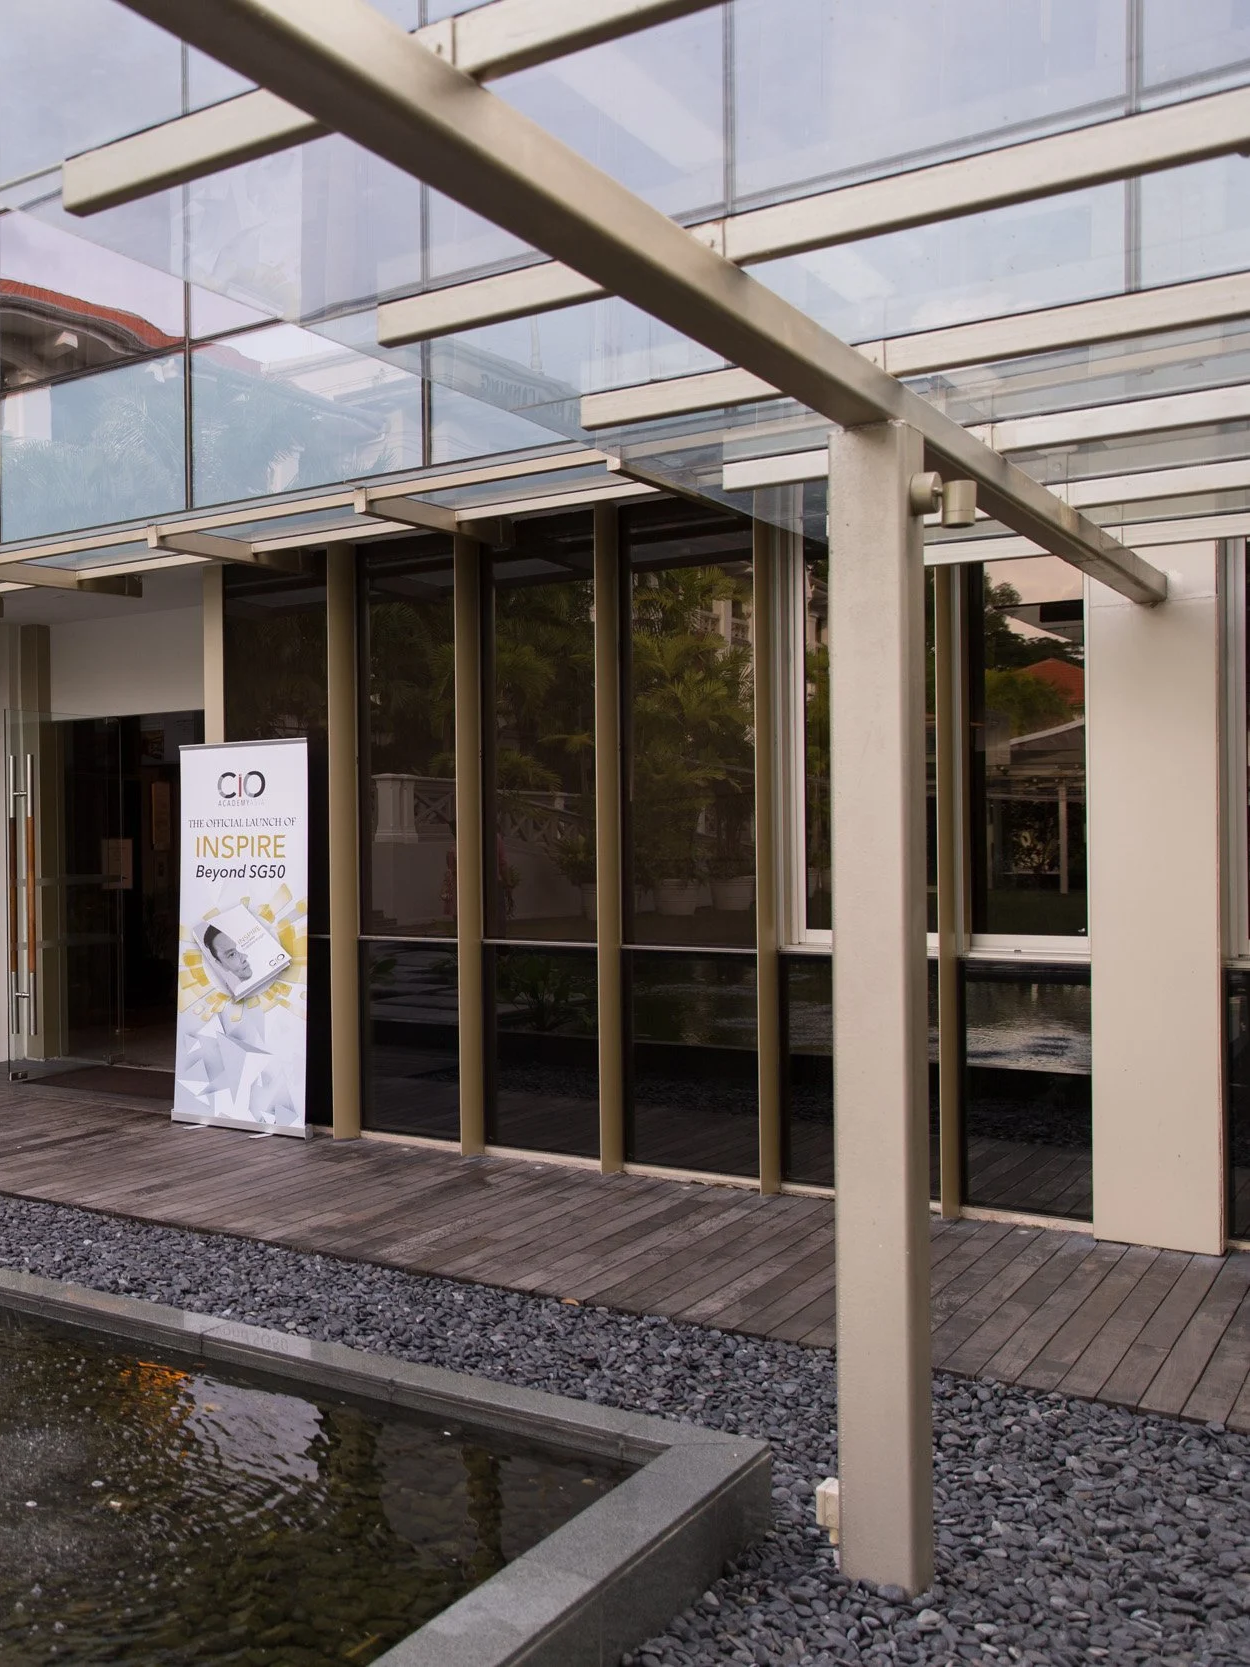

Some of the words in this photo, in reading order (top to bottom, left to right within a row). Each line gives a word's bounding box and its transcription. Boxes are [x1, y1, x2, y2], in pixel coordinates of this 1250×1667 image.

[188, 819, 204, 828] THE
[206, 818, 244, 828] OFFICIAL
[245, 817, 282, 827] LAUNCH
[283, 817, 297, 827] OF
[196, 834, 286, 859] INSPIRE
[196, 864, 246, 882] Beyond
[249, 864, 286, 879] SG50
